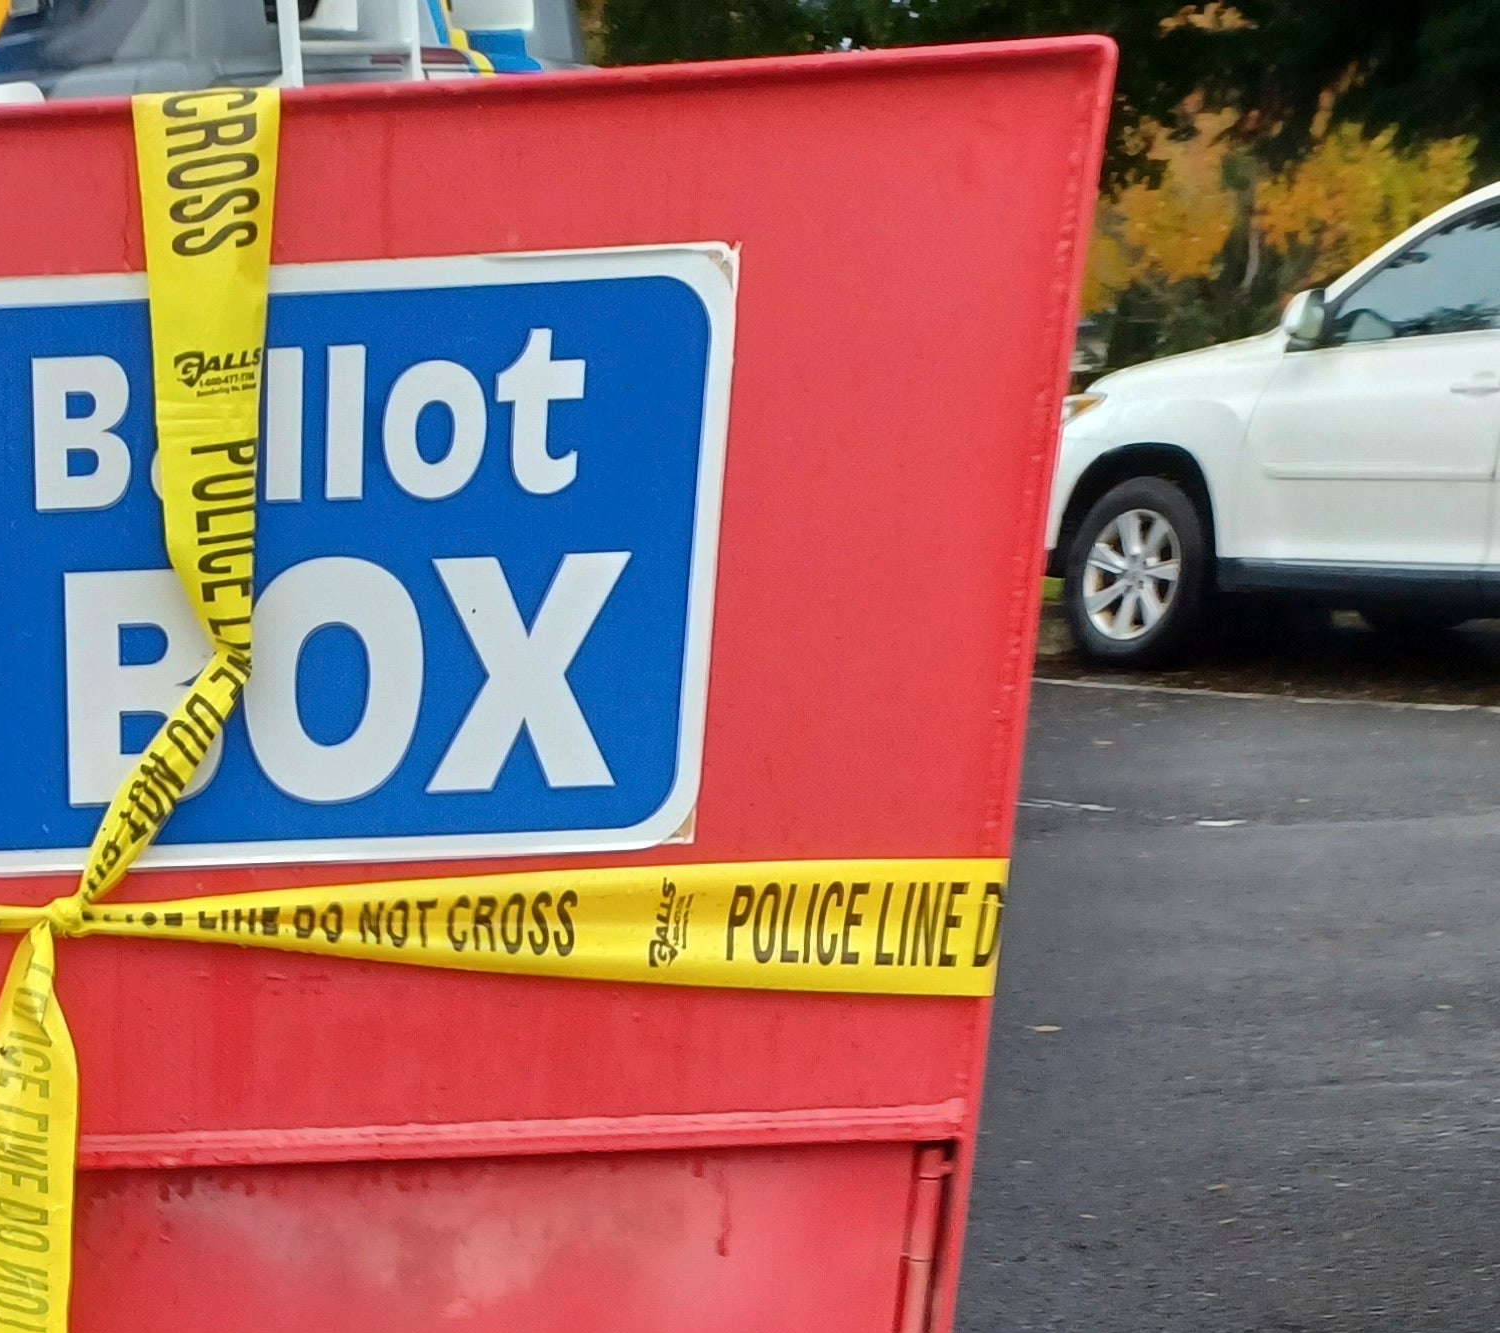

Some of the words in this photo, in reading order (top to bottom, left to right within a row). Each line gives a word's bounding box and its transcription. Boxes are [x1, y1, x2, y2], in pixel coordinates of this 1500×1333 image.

[162, 90, 260, 257] CROSS
[31, 327, 587, 512] Bllot
[173, 347, 261, 388] GALLS
[191, 438, 257, 602] POLICE
[63, 551, 632, 808] BOX
[358, 898, 437, 950] NOT
[446, 889, 579, 957] CROSS
[649, 877, 678, 967] GALLS
[726, 880, 870, 967] POLICE
[874, 880, 969, 968] LINE
